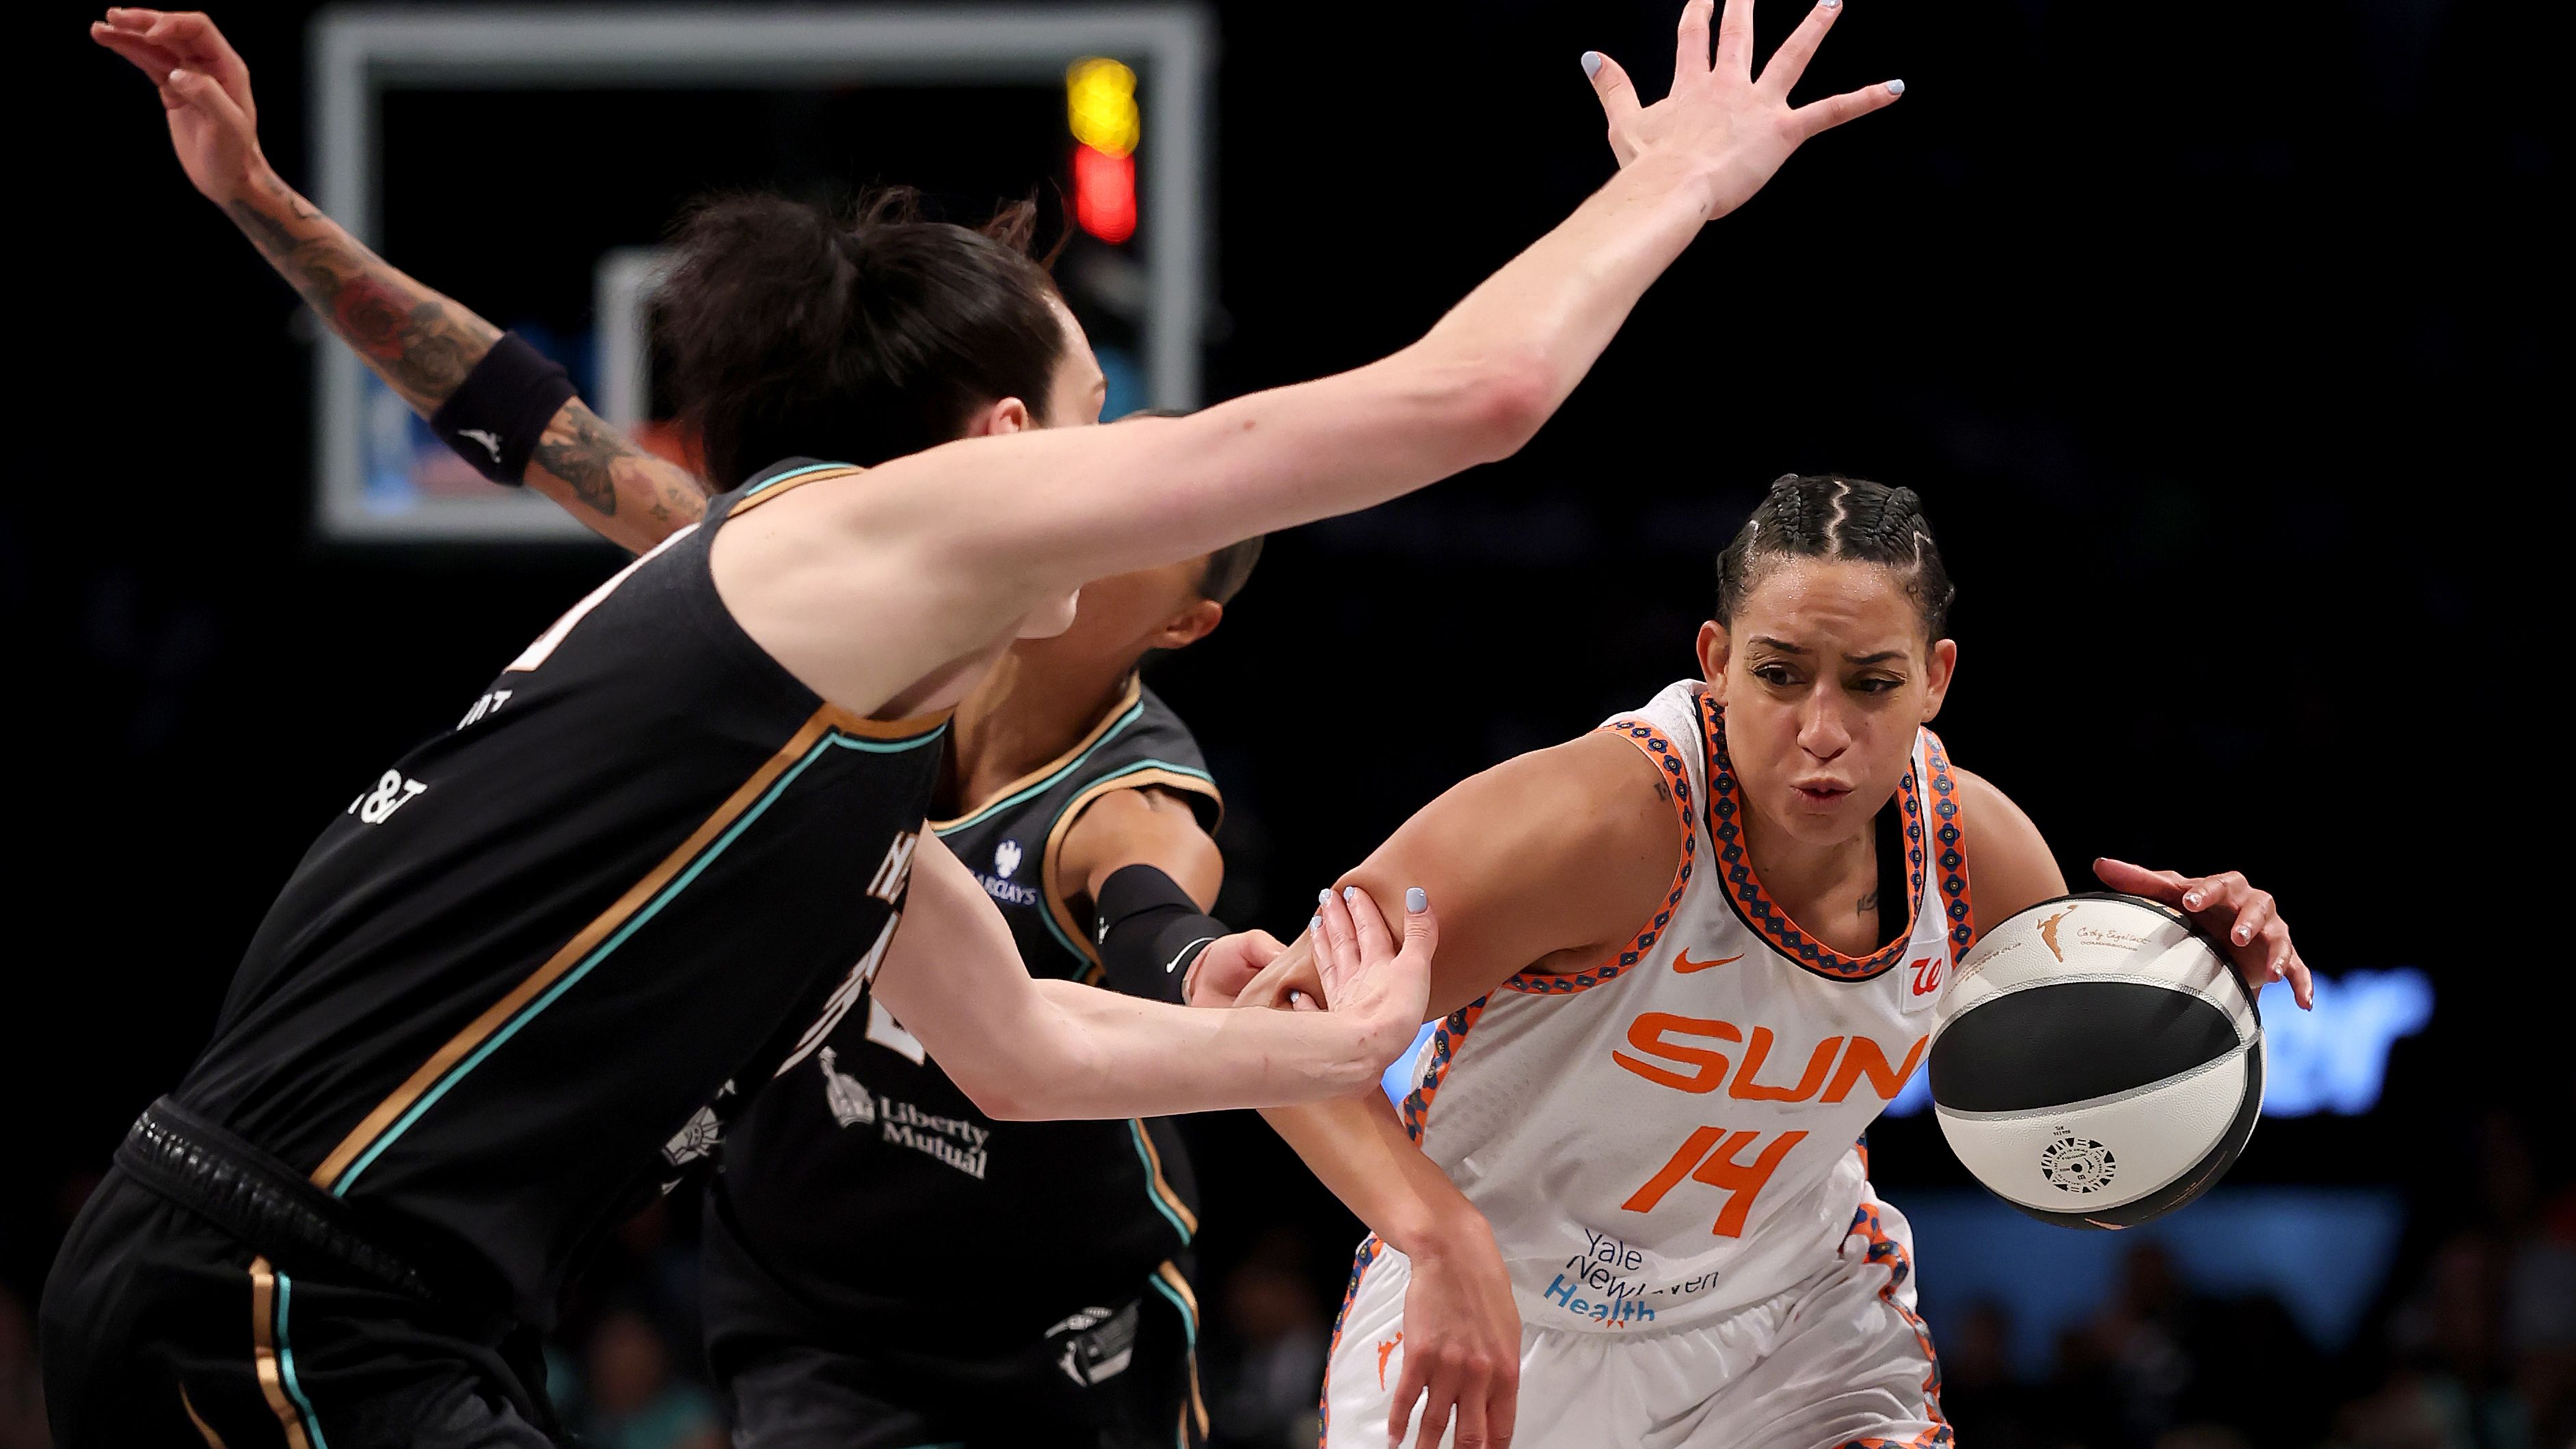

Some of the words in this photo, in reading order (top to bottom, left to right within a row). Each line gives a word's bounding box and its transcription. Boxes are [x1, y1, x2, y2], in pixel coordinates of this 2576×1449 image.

[1612, 1012, 1929, 1103] SUN
[880, 1096, 990, 1153] Liberty
[883, 1121, 988, 1180] Mutual
[1621, 1126, 1809, 1238] 14
[1585, 1228, 1642, 1271] Yale
[1544, 1273, 1655, 1321] Health
